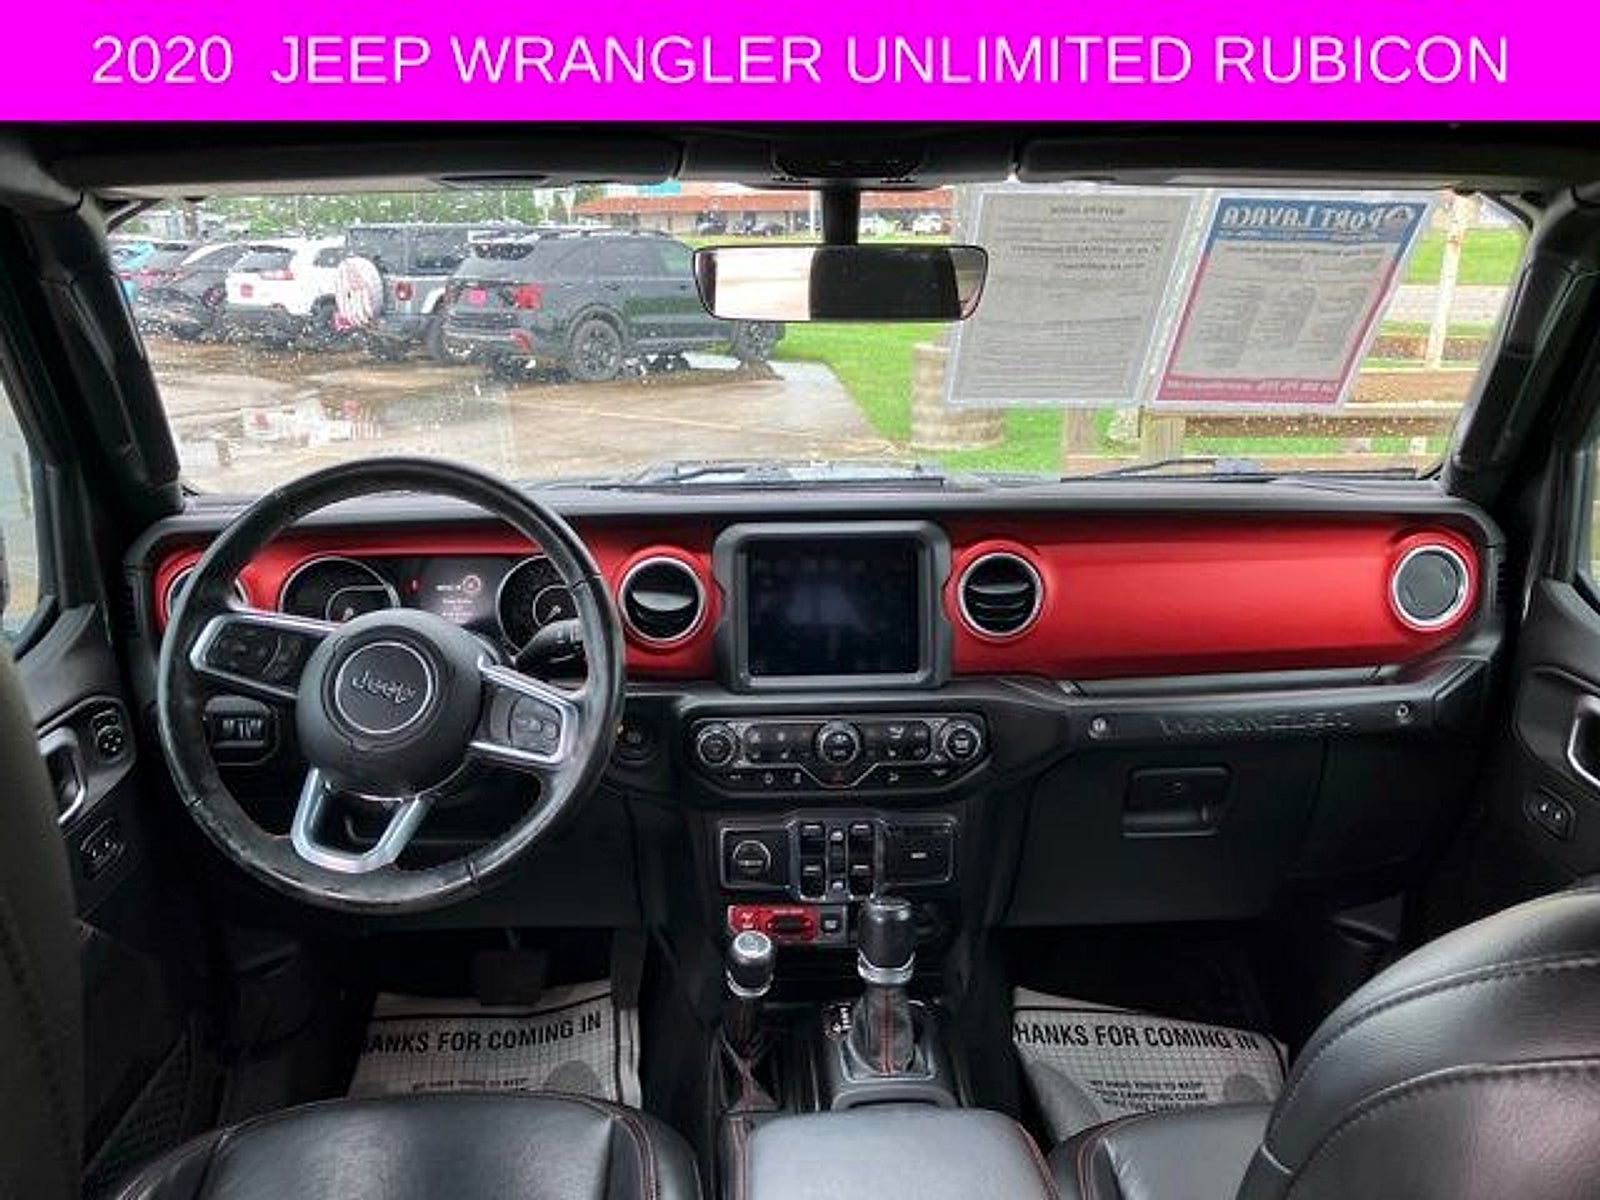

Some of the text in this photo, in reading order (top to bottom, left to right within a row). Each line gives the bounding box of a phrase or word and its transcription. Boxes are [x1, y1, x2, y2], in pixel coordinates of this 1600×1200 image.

[437, 1031, 481, 1051] FOR
[487, 1020, 574, 1050] COMING
[1014, 1023, 1089, 1046] HANKS
[1095, 1025, 1140, 1048] FOR
[1145, 1027, 1234, 1050] COMING
